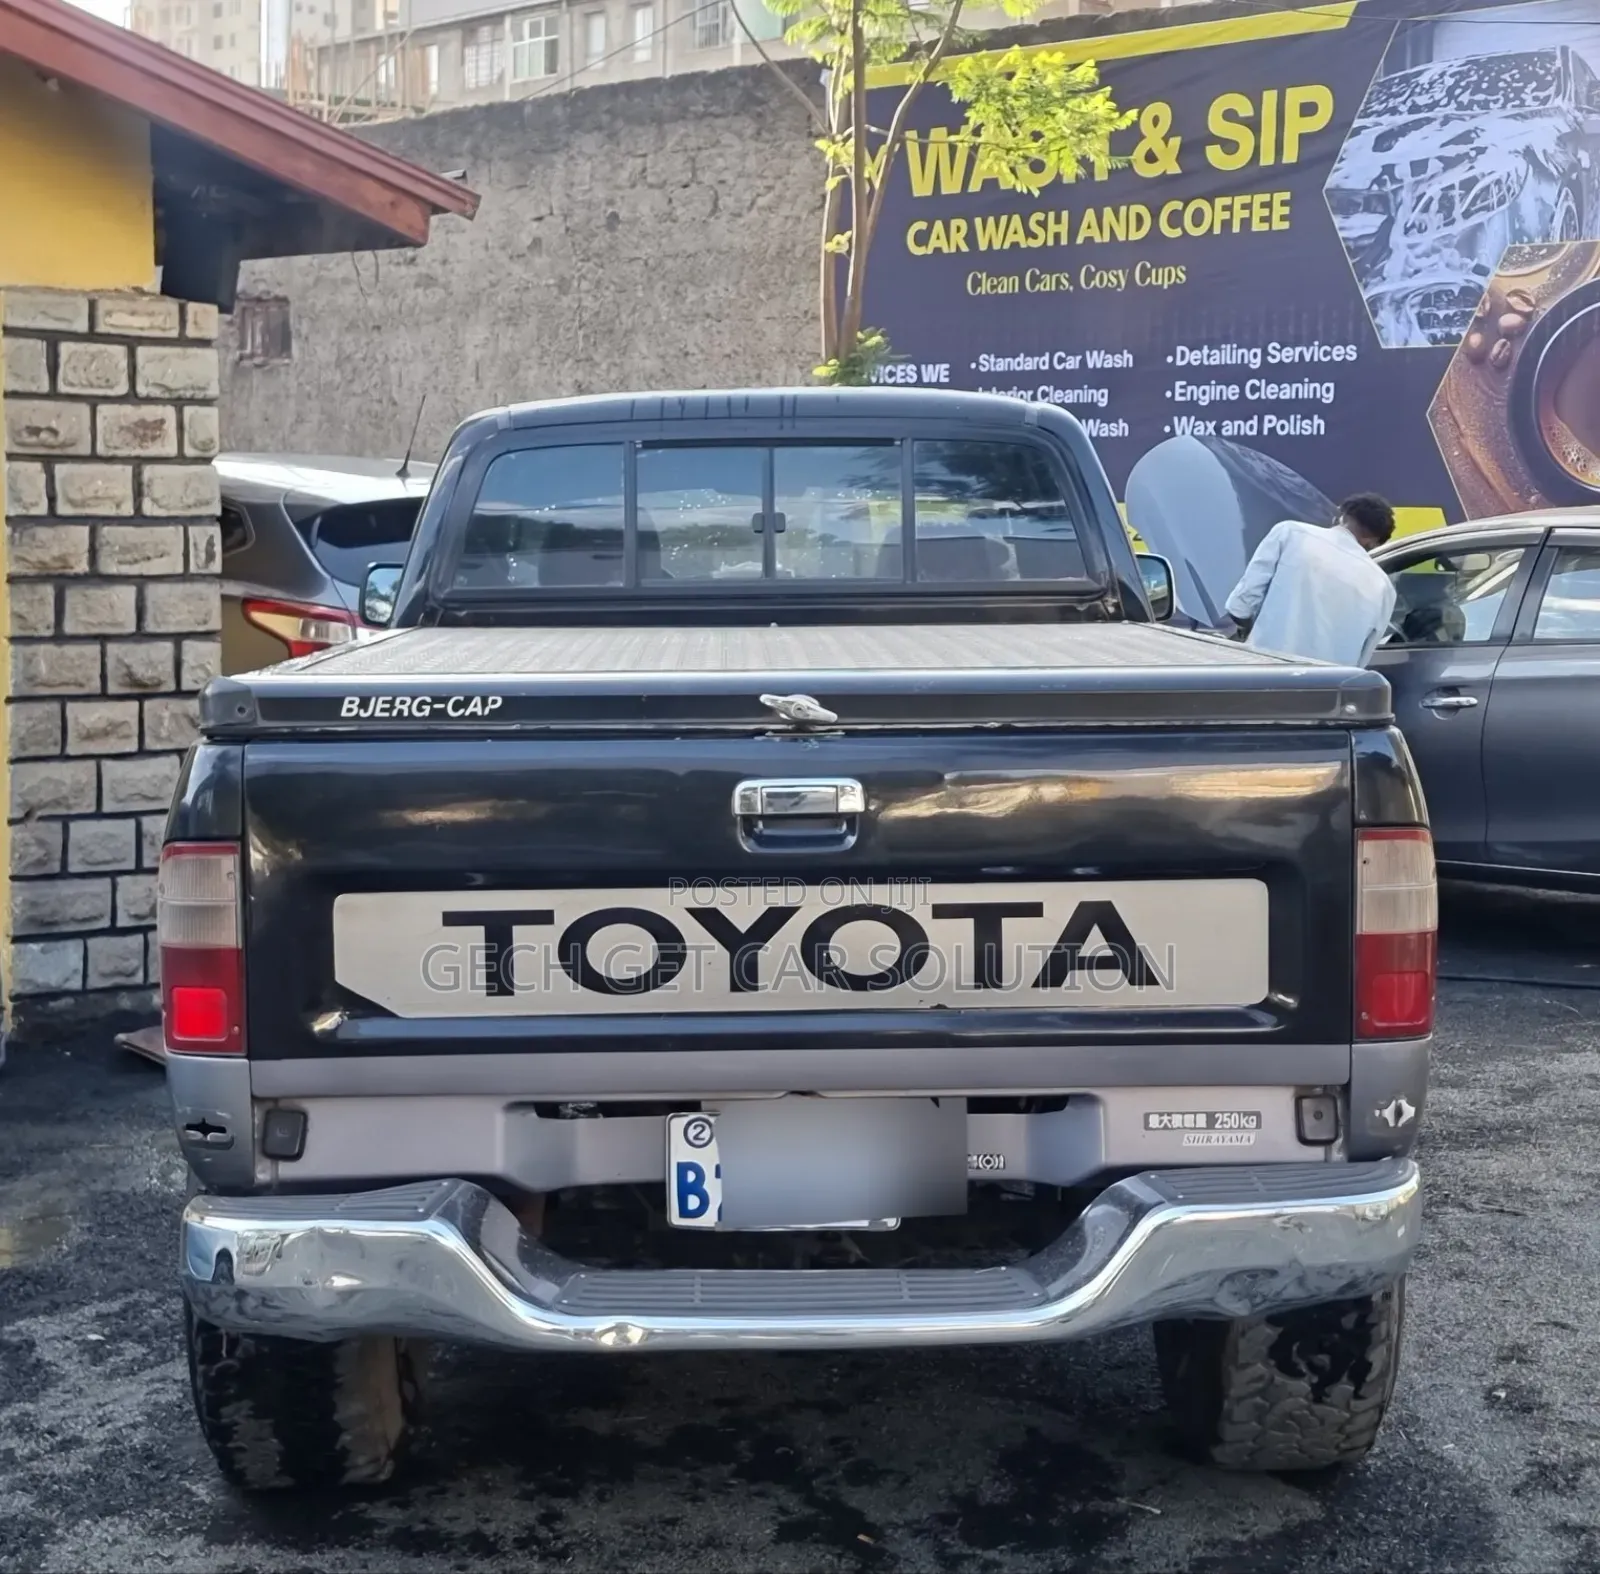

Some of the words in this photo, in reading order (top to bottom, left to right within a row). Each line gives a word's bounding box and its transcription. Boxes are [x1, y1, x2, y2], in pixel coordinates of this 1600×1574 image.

[1132, 101, 1182, 178] &
[1205, 84, 1334, 171] SIP
[906, 219, 969, 256] CAR
[975, 210, 1068, 251] WASH
[1076, 203, 1152, 245] AND
[1158, 191, 1292, 238] COFFEE
[966, 270, 1019, 296] Clean
[1025, 267, 1074, 293] Cars,
[1079, 263, 1129, 291] Cosy
[1134, 260, 1187, 288] Cups
[978, 353, 1049, 372] Standard
[1053, 351, 1081, 370] Car
[1085, 349, 1134, 369] Wash
[1176, 343, 1262, 369] Detailing
[1266, 341, 1358, 364] Services
[864, 363, 918, 385] VICES
[920, 363, 950, 383] WE
[1037, 385, 1109, 407] Cleaning
[1174, 380, 1240, 406] Engine
[1245, 377, 1335, 404] Cleaning
[1081, 418, 1130, 437] Wash
[1173, 416, 1217, 437] Wax
[1221, 415, 1259, 436] and
[1263, 414, 1326, 436] Polish
[340, 695, 503, 719] BJERG-CAP
[442, 900, 1160, 997] TOYOTA
[1214, 1113, 1257, 1129] 250kg
